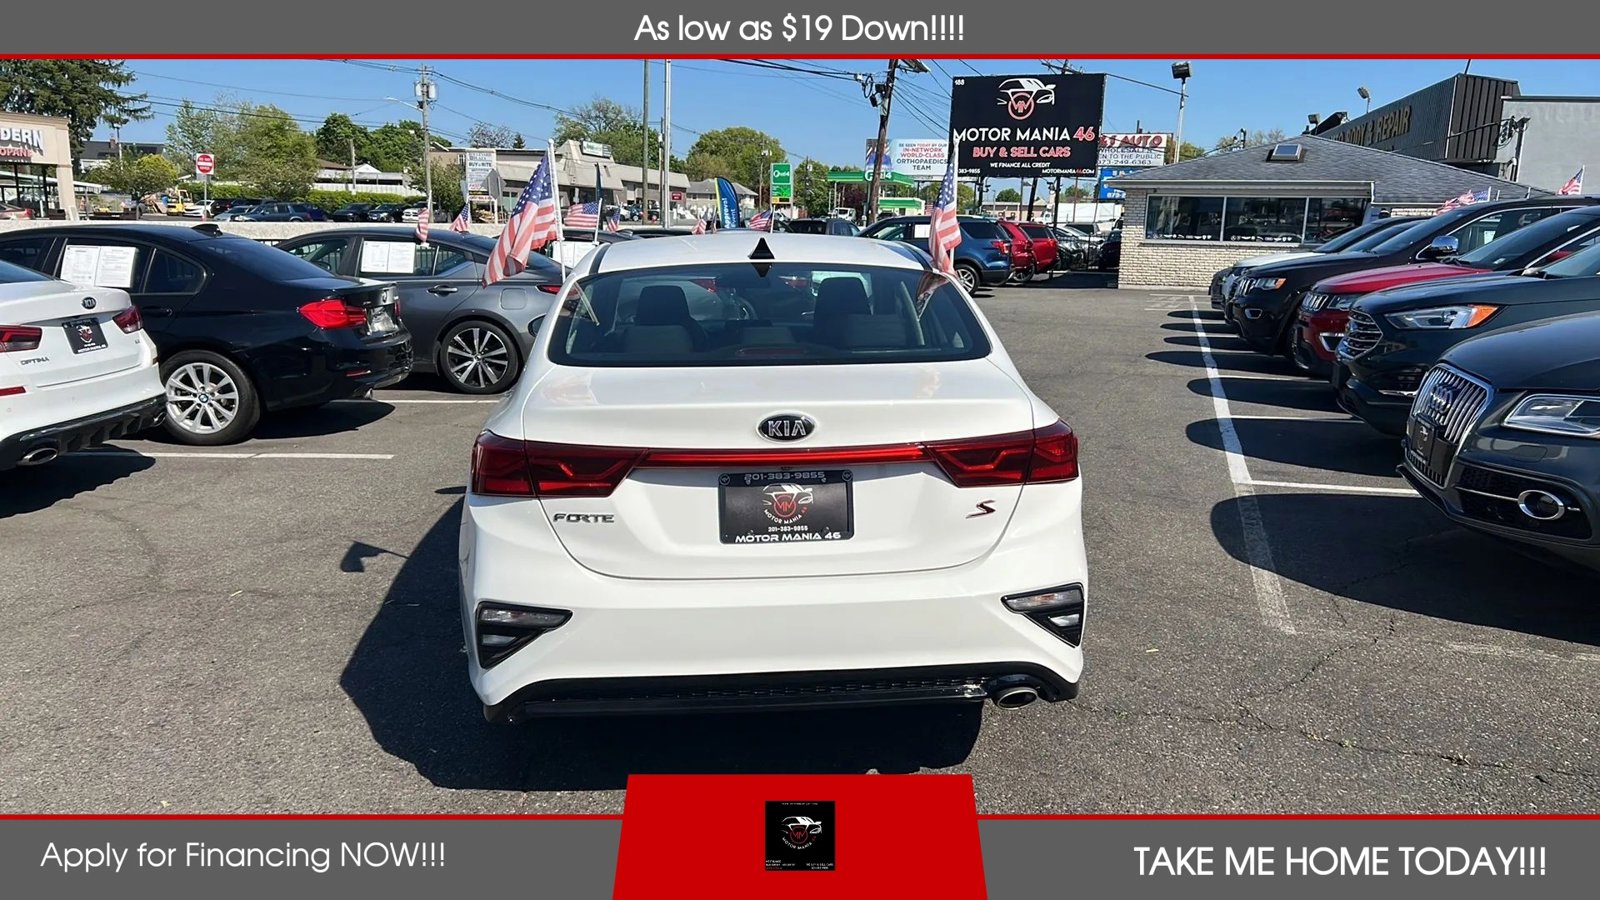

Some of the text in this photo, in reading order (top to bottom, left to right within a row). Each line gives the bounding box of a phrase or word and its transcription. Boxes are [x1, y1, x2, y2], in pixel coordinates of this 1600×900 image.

[1376, 105, 1412, 143] REPAIR
[953, 126, 1096, 142] MOTOR MANIA 46
[1120, 135, 1163, 147] AUTO
[972, 146, 1071, 158] BUY & SELL CARS
[768, 420, 807, 437] KIA
[744, 471, 825, 481] 201-383-9855
[553, 513, 615, 523] FORTE
[764, 509, 783, 524] MOTOR
[783, 514, 802, 524] MANIA
[735, 532, 842, 543] MOTOR MANIA 46
